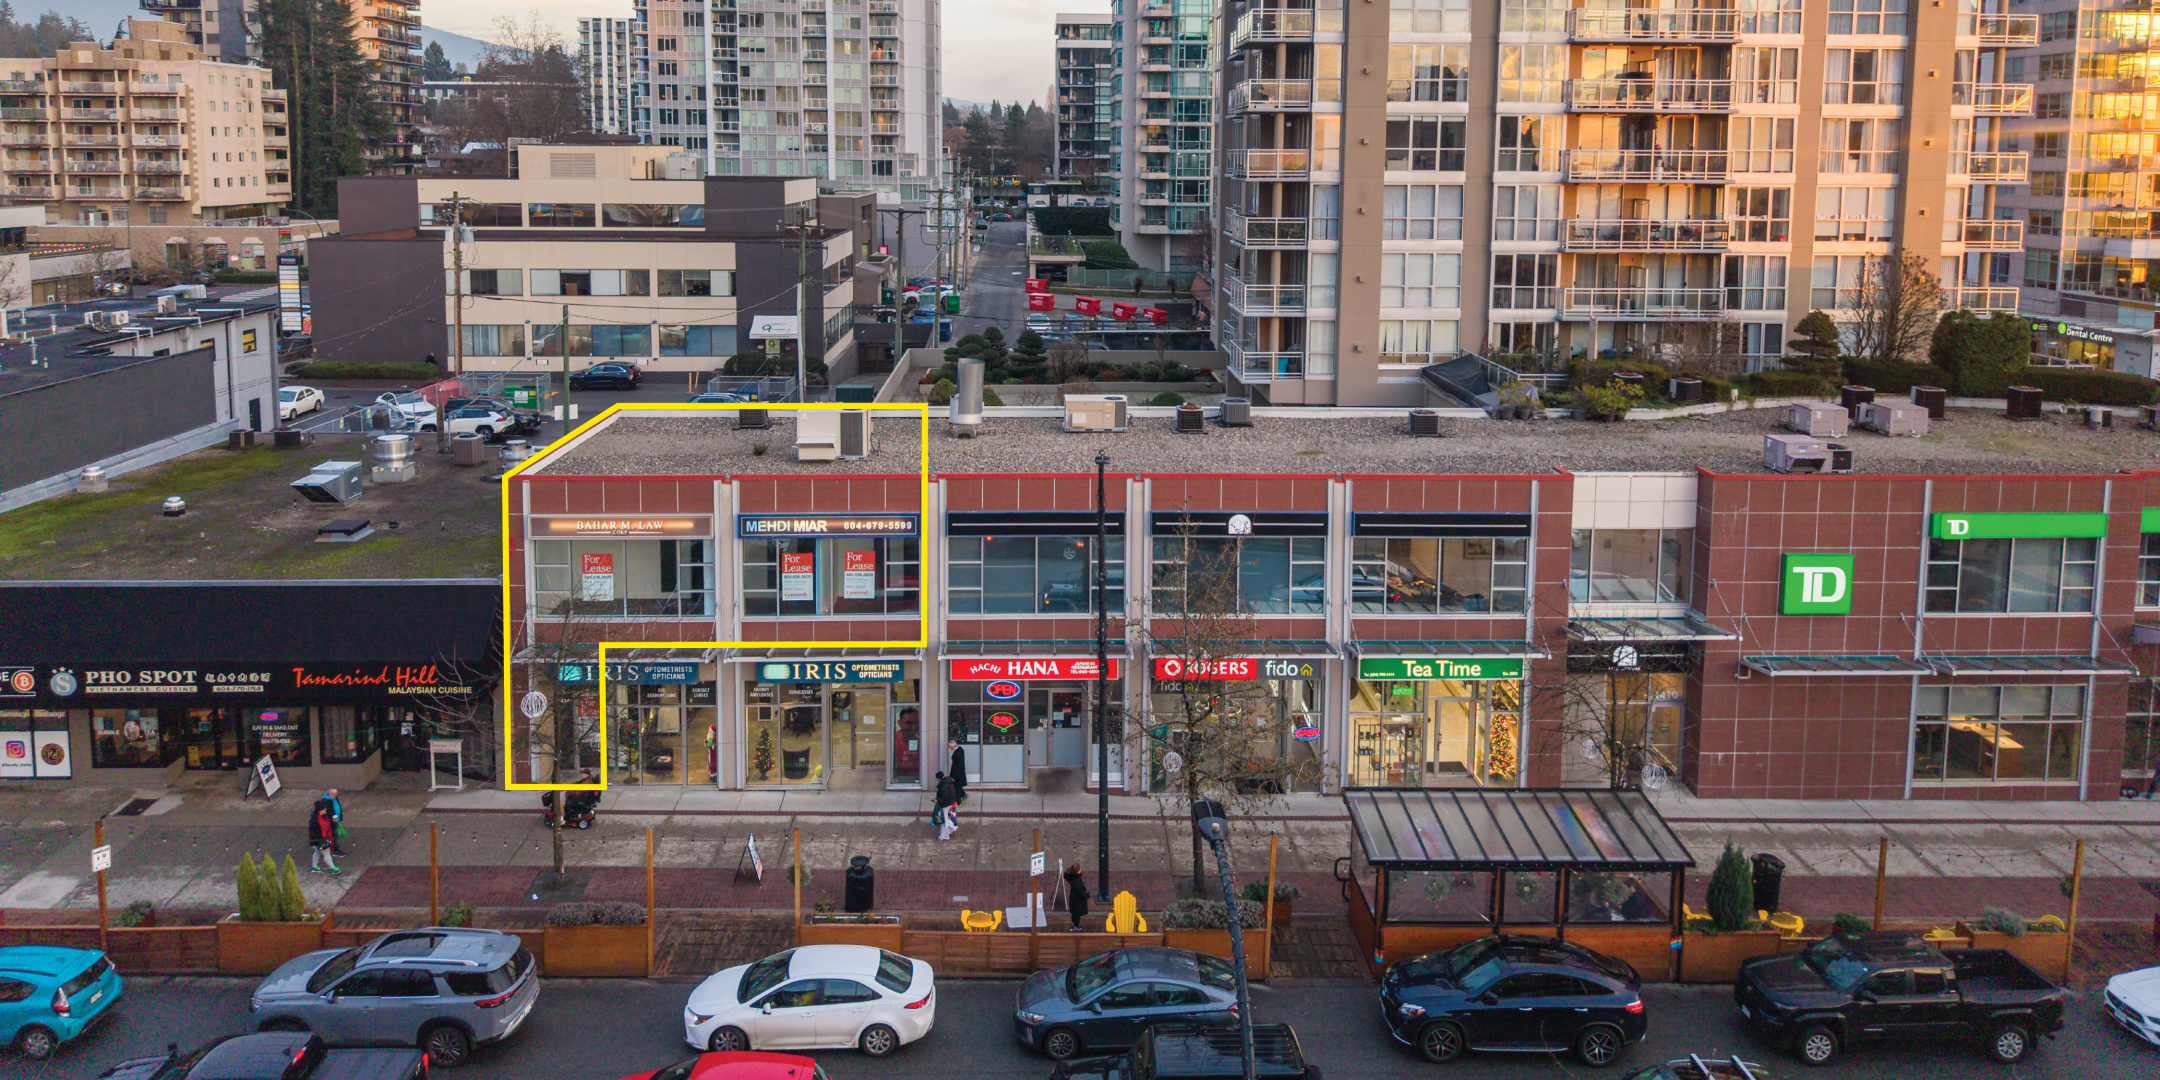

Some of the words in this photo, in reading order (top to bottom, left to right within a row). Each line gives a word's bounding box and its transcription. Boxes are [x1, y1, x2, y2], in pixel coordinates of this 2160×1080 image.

[2066, 329, 2088, 339] Dental
[2089, 332, 2113, 343] Centre
[576, 521, 617, 530] BAHAR
[621, 521, 635, 530] M.
[638, 521, 664, 529] LAW
[746, 521, 791, 532] MEHDI
[793, 520, 828, 532] MIAR
[843, 521, 912, 530] 604-679-5599
[1946, 519, 1969, 535] TD
[584, 554, 600, 564] For
[784, 554, 800, 563] For
[847, 552, 863, 561] For
[584, 563, 612, 573] Lease
[784, 563, 811, 573] Lease
[847, 561, 874, 570] Lease
[1792, 566, 1847, 603] TD
[585, 665, 639, 681] IRIS
[792, 663, 847, 680] IRIS
[970, 663, 1001, 674] HACHI
[1008, 661, 1059, 675] HANA
[1187, 662, 1248, 674] ROGERS
[1265, 660, 1298, 676] fido
[1402, 660, 1432, 677] Tea
[1435, 660, 1481, 677] Time
[85, 671, 132, 684] PHO
[139, 670, 198, 684] SPOT
[292, 665, 391, 689] Tamarind
[396, 664, 439, 688] Hill
[56, 675, 71, 693] S
[989, 684, 1017, 695] OPEN
[1655, 690, 1678, 699] 1410
[992, 715, 1014, 726] SUSHI
